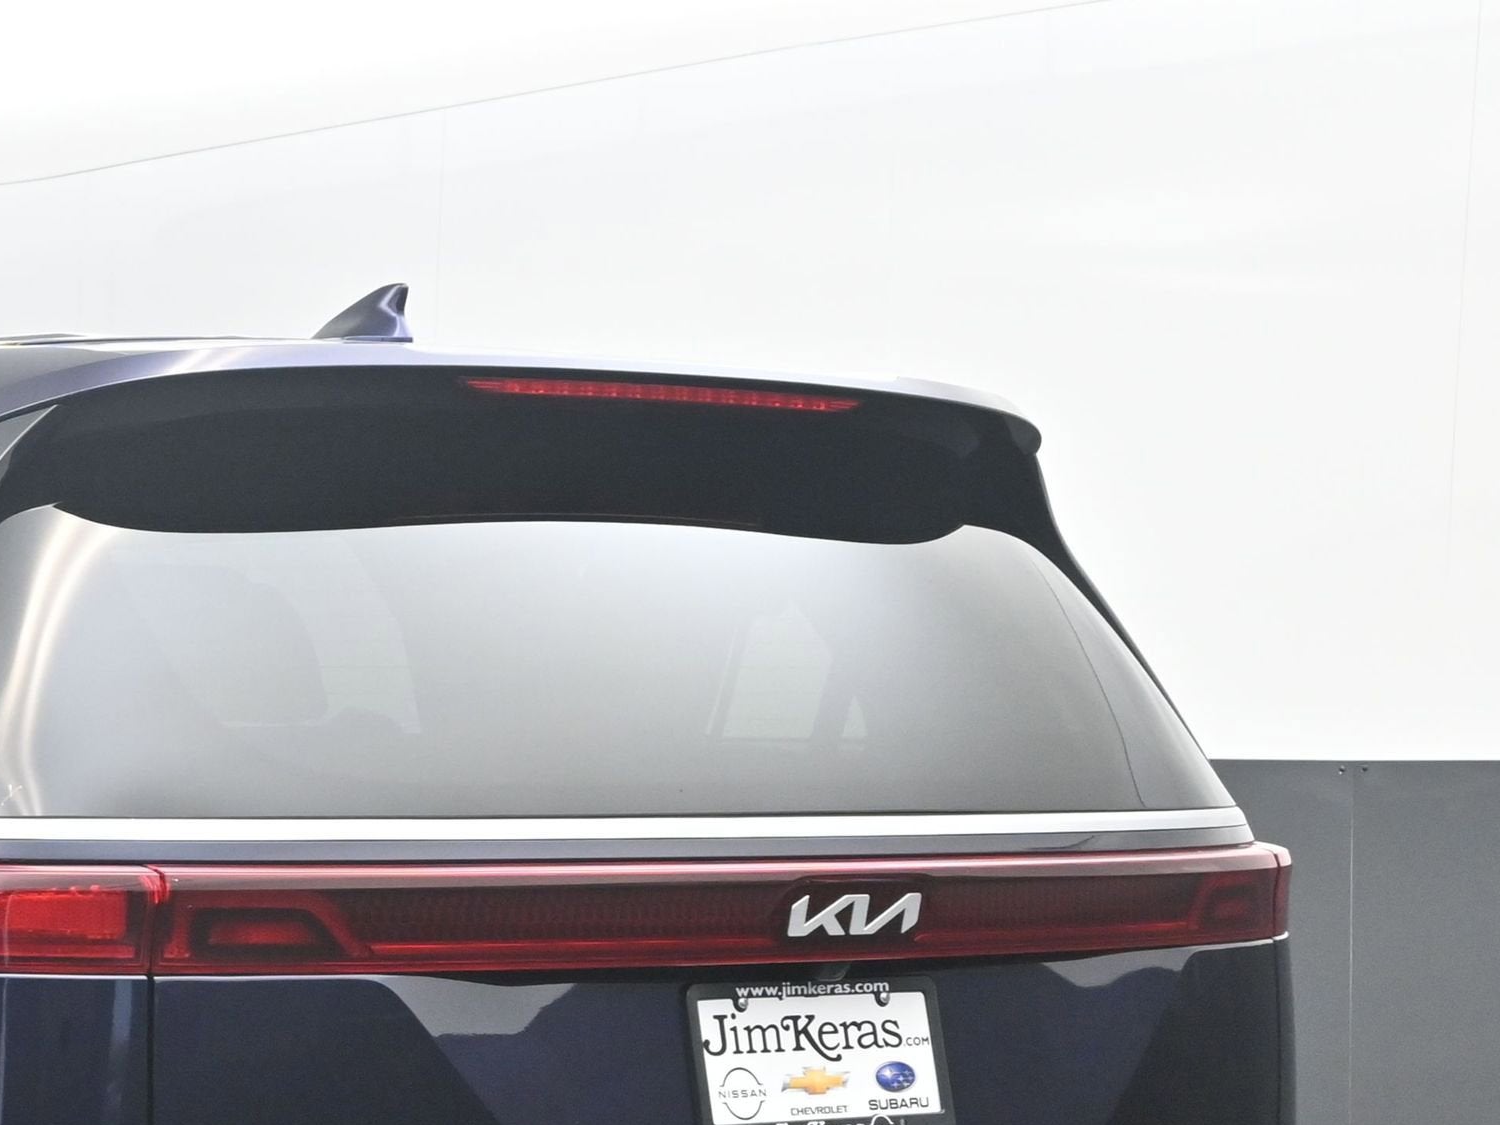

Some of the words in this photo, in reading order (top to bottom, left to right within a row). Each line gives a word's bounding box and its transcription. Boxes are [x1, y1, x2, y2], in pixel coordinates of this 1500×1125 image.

[787, 893, 922, 937] KIA
[735, 981, 890, 999] www.jimkeras.com
[718, 1089, 767, 1098] NISSAN
[790, 1105, 849, 1117] CHEVROLET
[868, 1097, 930, 1111] SUBARU
